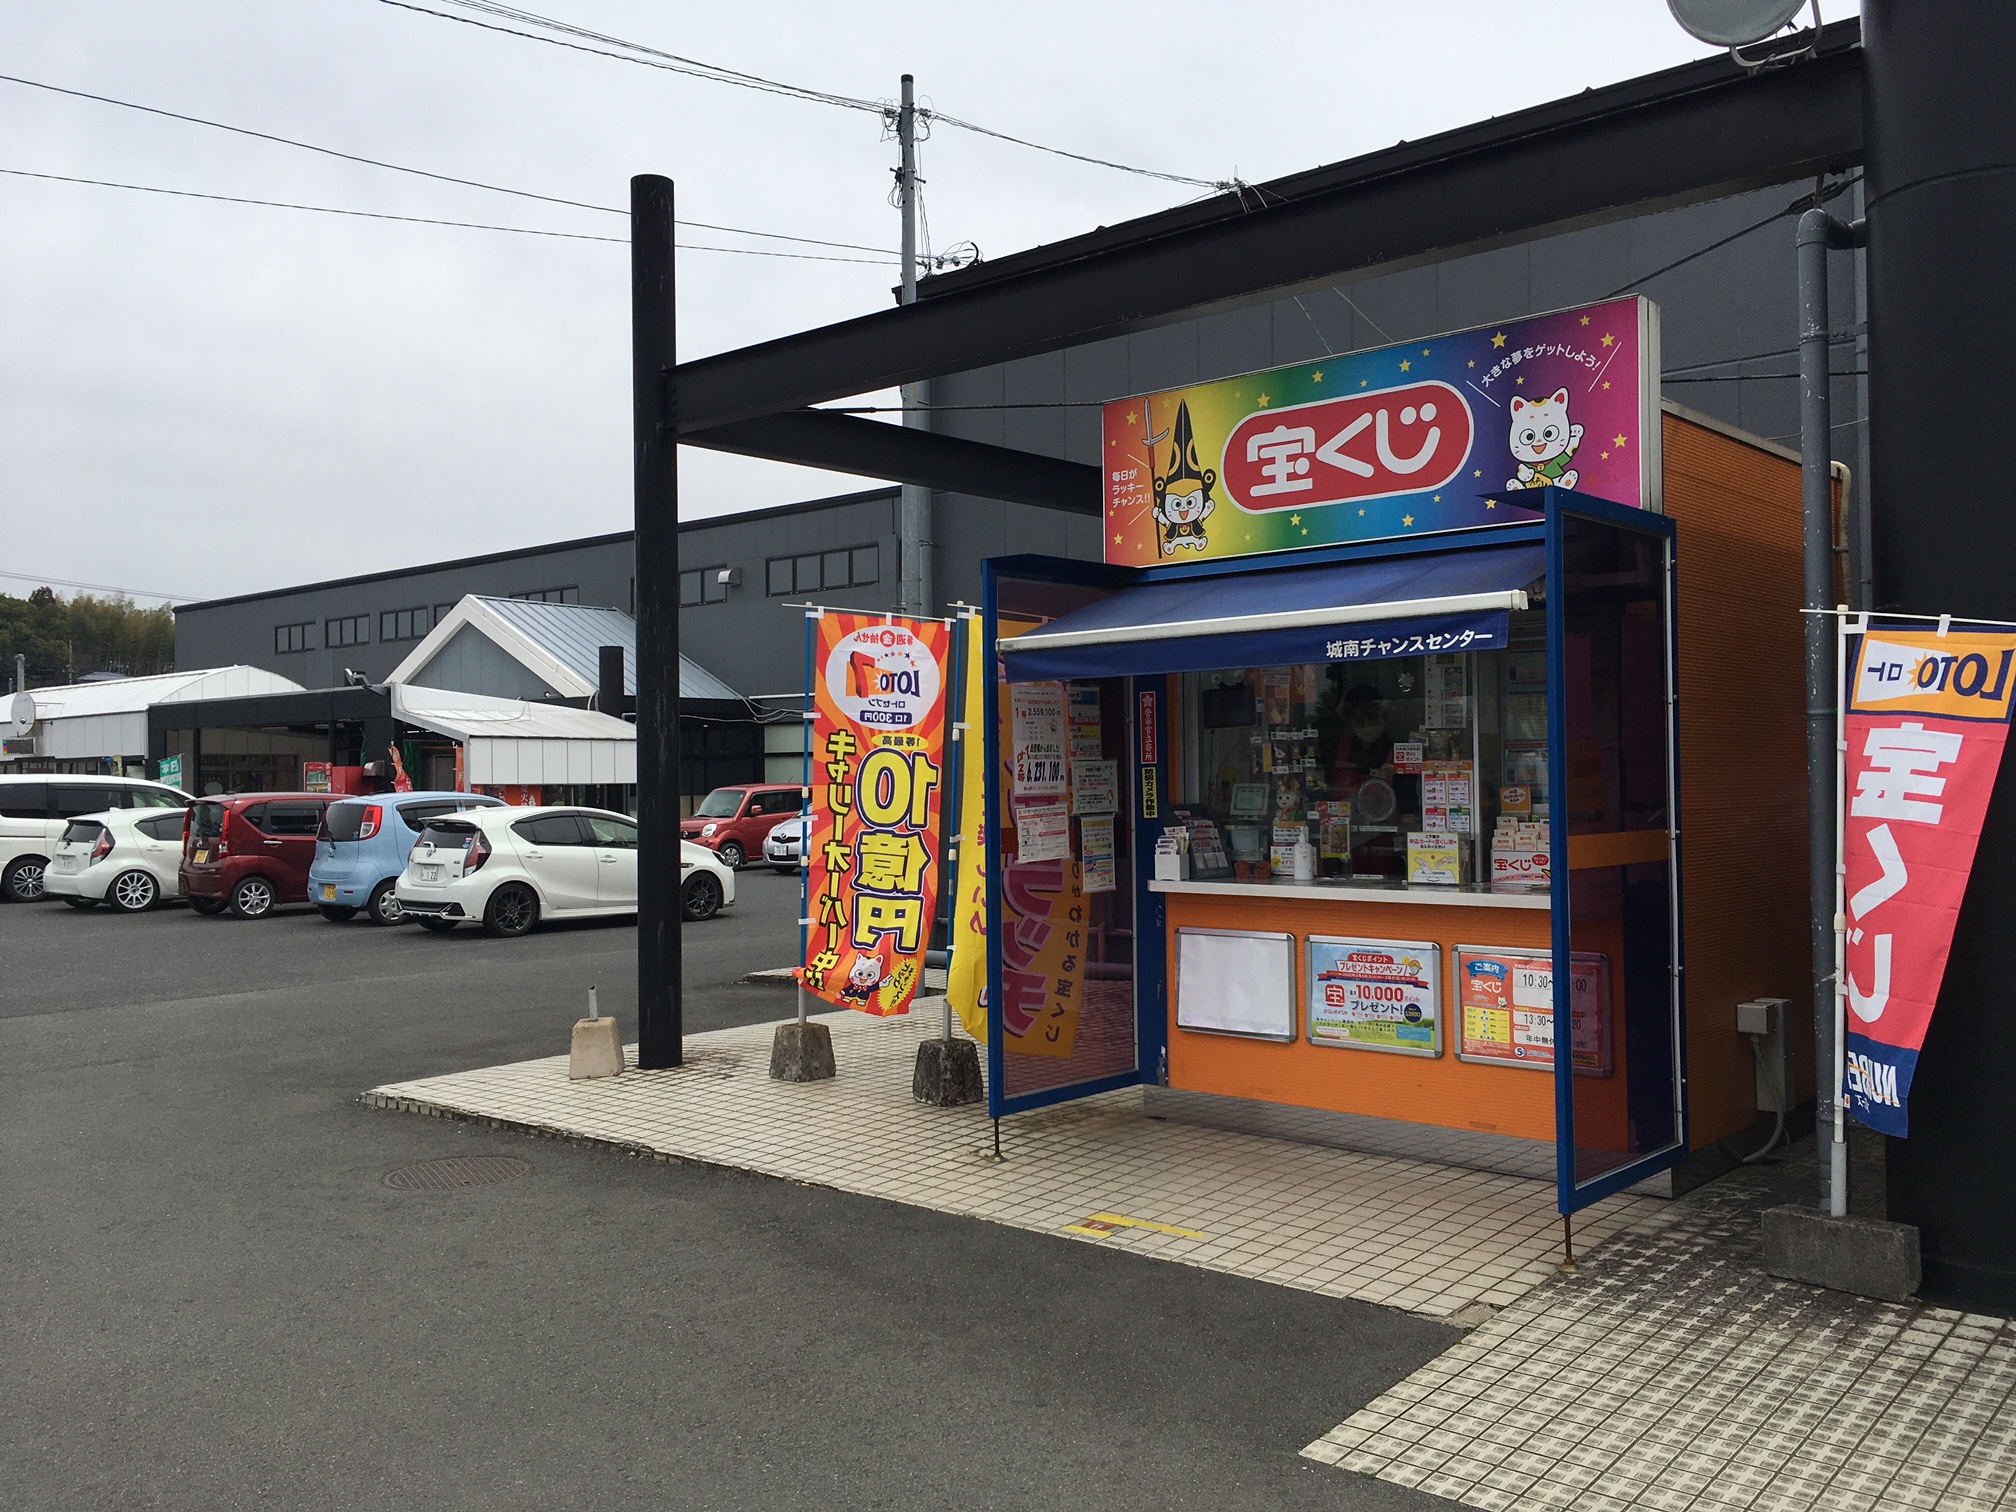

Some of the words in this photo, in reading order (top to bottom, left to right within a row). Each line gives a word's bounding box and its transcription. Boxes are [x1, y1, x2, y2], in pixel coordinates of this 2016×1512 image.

[1481, 343, 1602, 388] 大きな夢をゲットしよう!
[1246, 402, 1442, 498] 宝くじ
[1111, 468, 1138, 482] 毎日が
[1112, 483, 1144, 496] ラッキー
[1326, 631, 1493, 659] 城南チャンスセンター
[1145, 768, 1155, 818] 防犯カメラ作動中
[1494, 858, 1532, 871] 宝くじ
[1352, 954, 1389, 963] 宝くじポイント
[1340, 961, 1404, 974] プレゼントキャンペーン
[1474, 962, 1499, 974] ご案内
[1471, 979, 1502, 993] 宝くじ
[1356, 985, 1404, 1003] 10,000
[1350, 1000, 1403, 1015] プレゼント!
